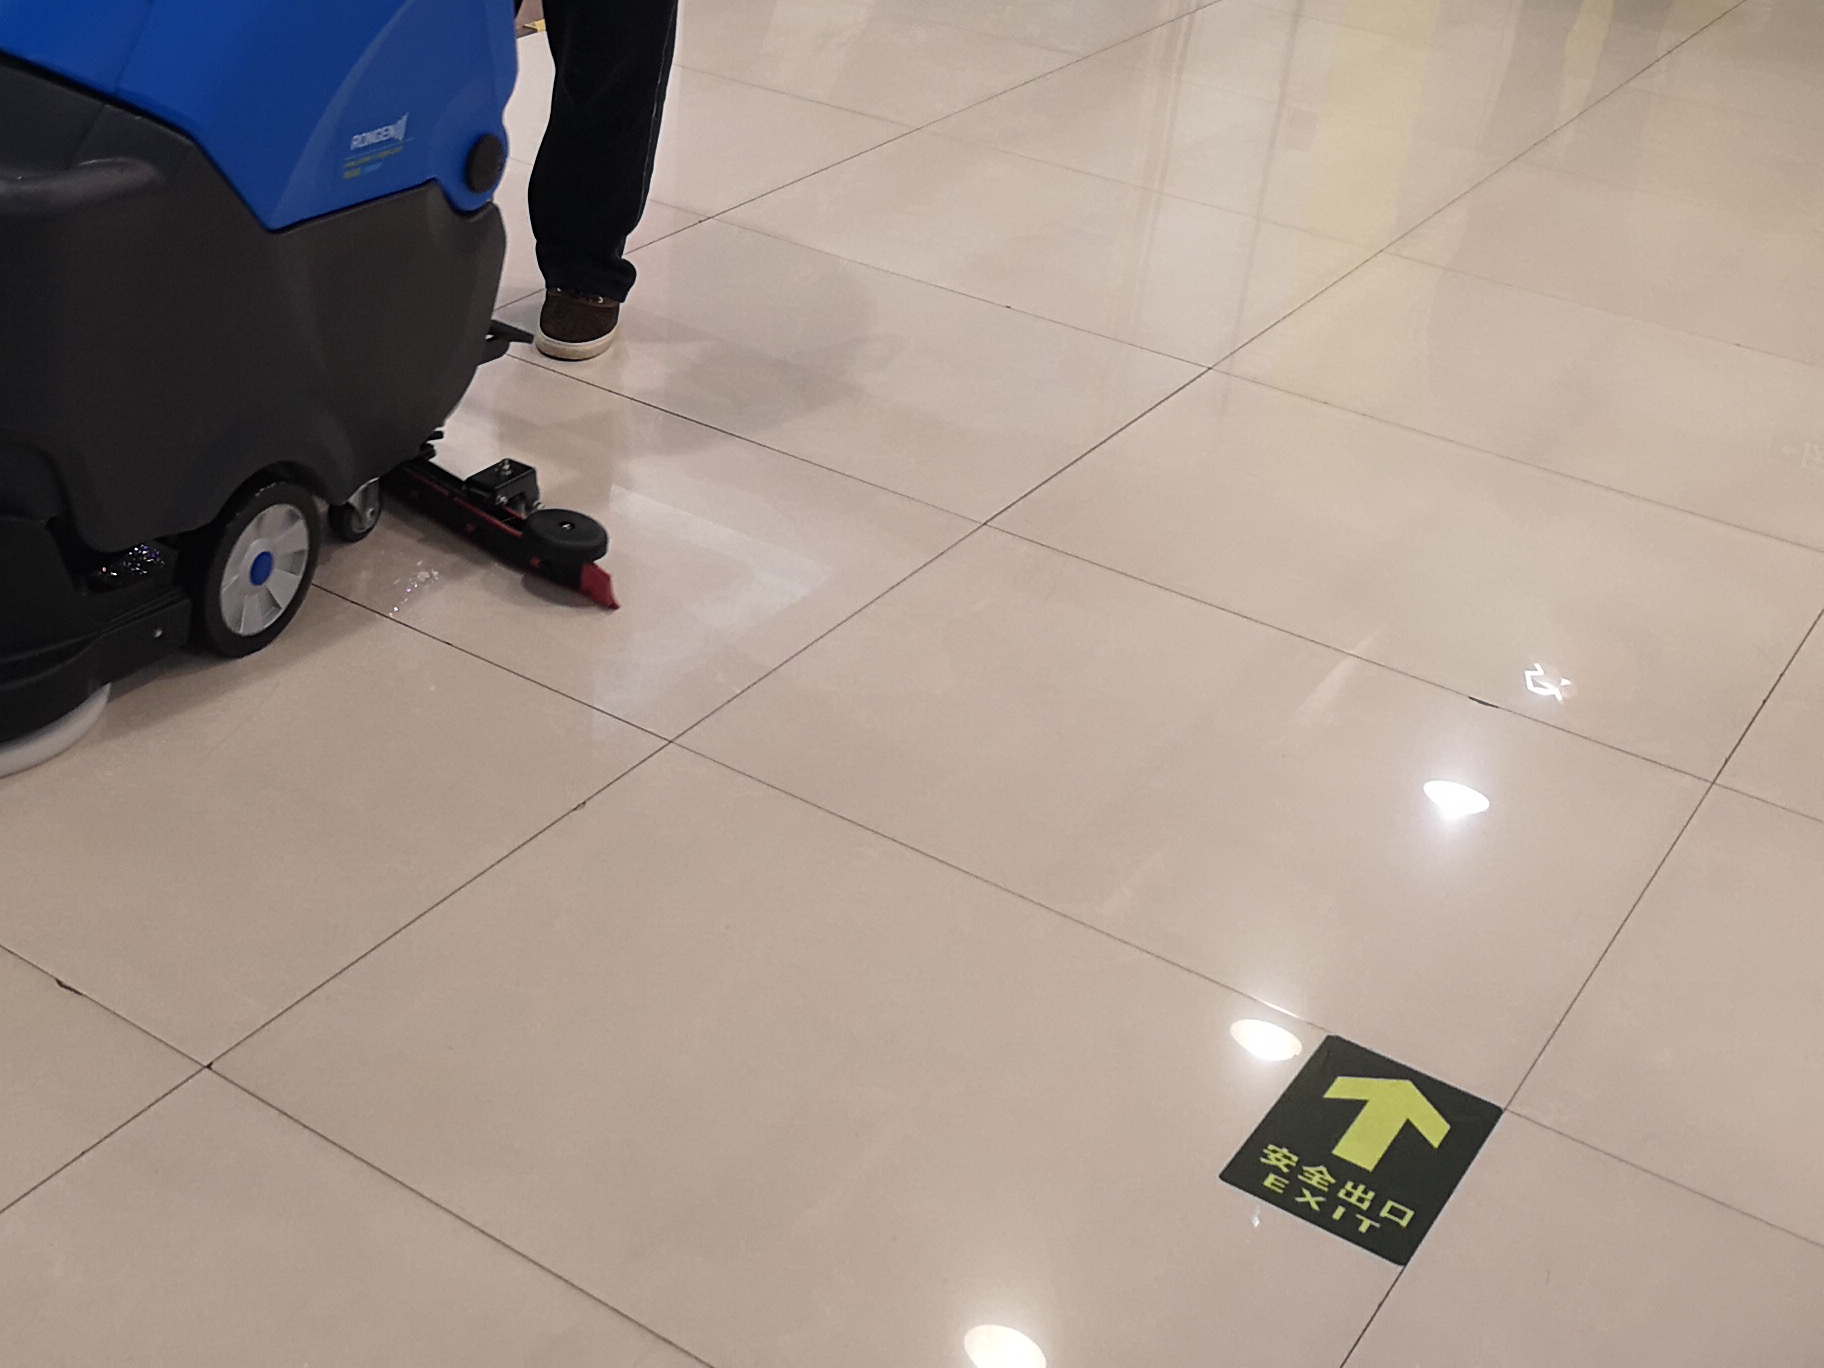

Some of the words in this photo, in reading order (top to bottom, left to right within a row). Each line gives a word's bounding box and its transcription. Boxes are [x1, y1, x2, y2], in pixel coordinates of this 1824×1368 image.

[1259, 1144, 1415, 1228] 安全出口
[1263, 1173, 1380, 1233] EXIT
